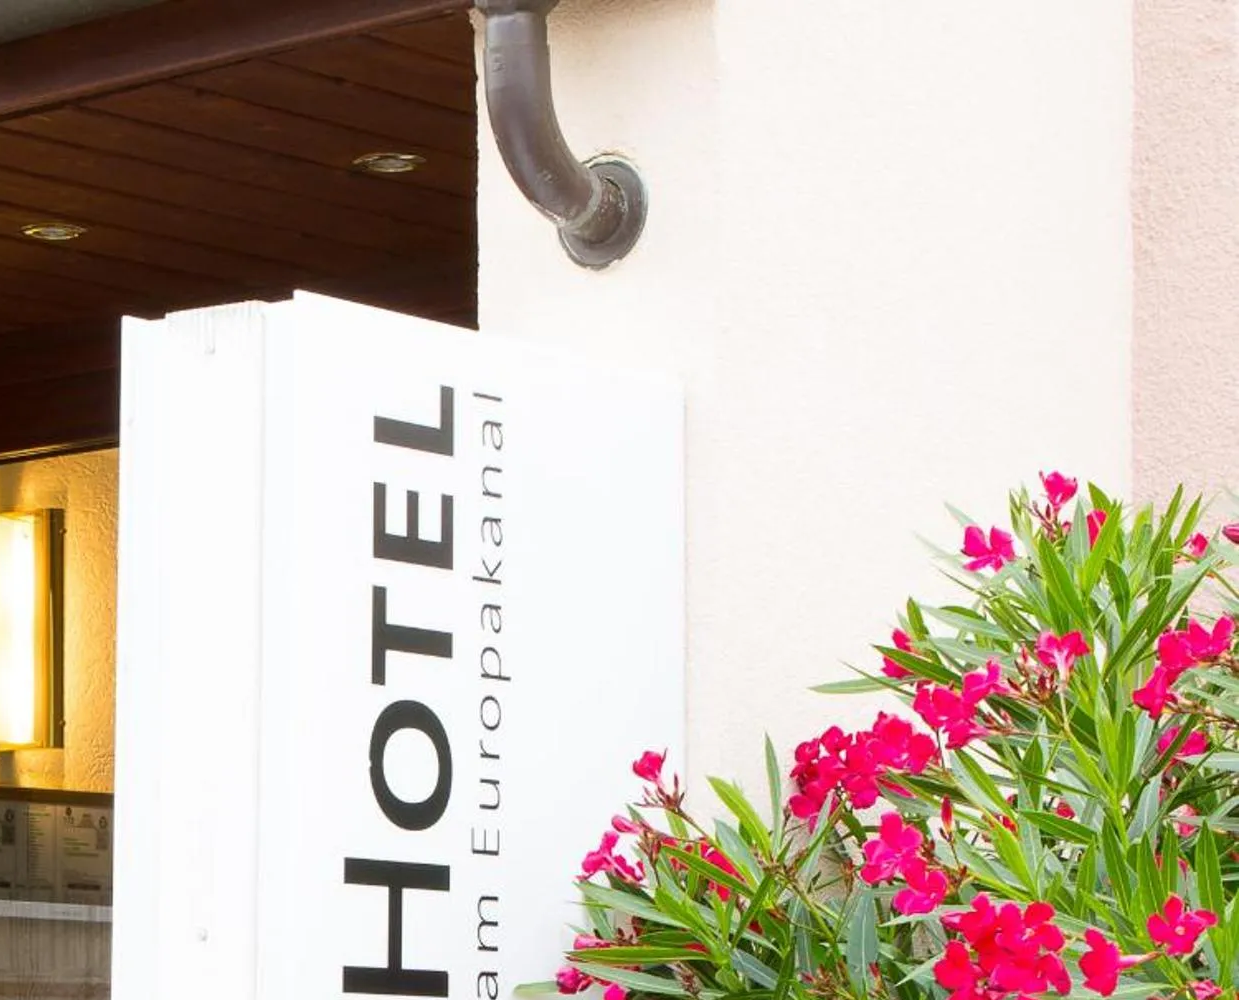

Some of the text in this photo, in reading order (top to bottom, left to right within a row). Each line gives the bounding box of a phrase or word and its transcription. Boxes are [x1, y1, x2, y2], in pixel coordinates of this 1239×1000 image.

[342, 385, 454, 998] HOTEL
[472, 391, 511, 1000] am Europakanal
